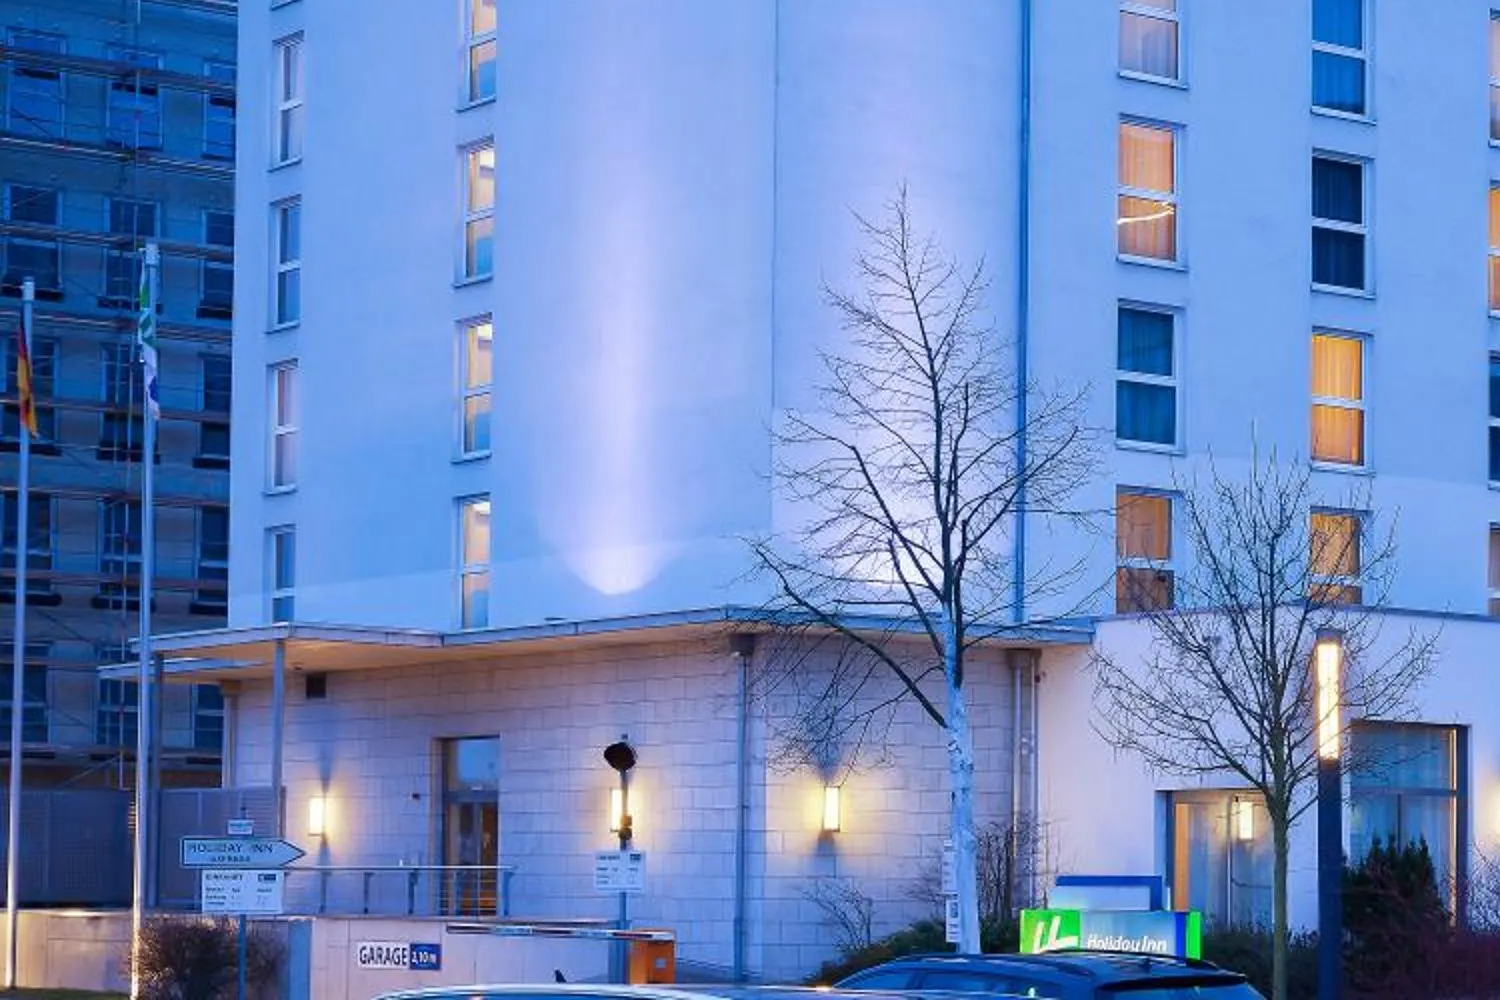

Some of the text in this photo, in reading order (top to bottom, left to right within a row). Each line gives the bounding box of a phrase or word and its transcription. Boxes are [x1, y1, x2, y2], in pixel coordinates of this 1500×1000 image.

[1087, 933, 1140, 952] Holiday
[1140, 935, 1167, 952] Inn
[359, 945, 407, 966] GARAGE
